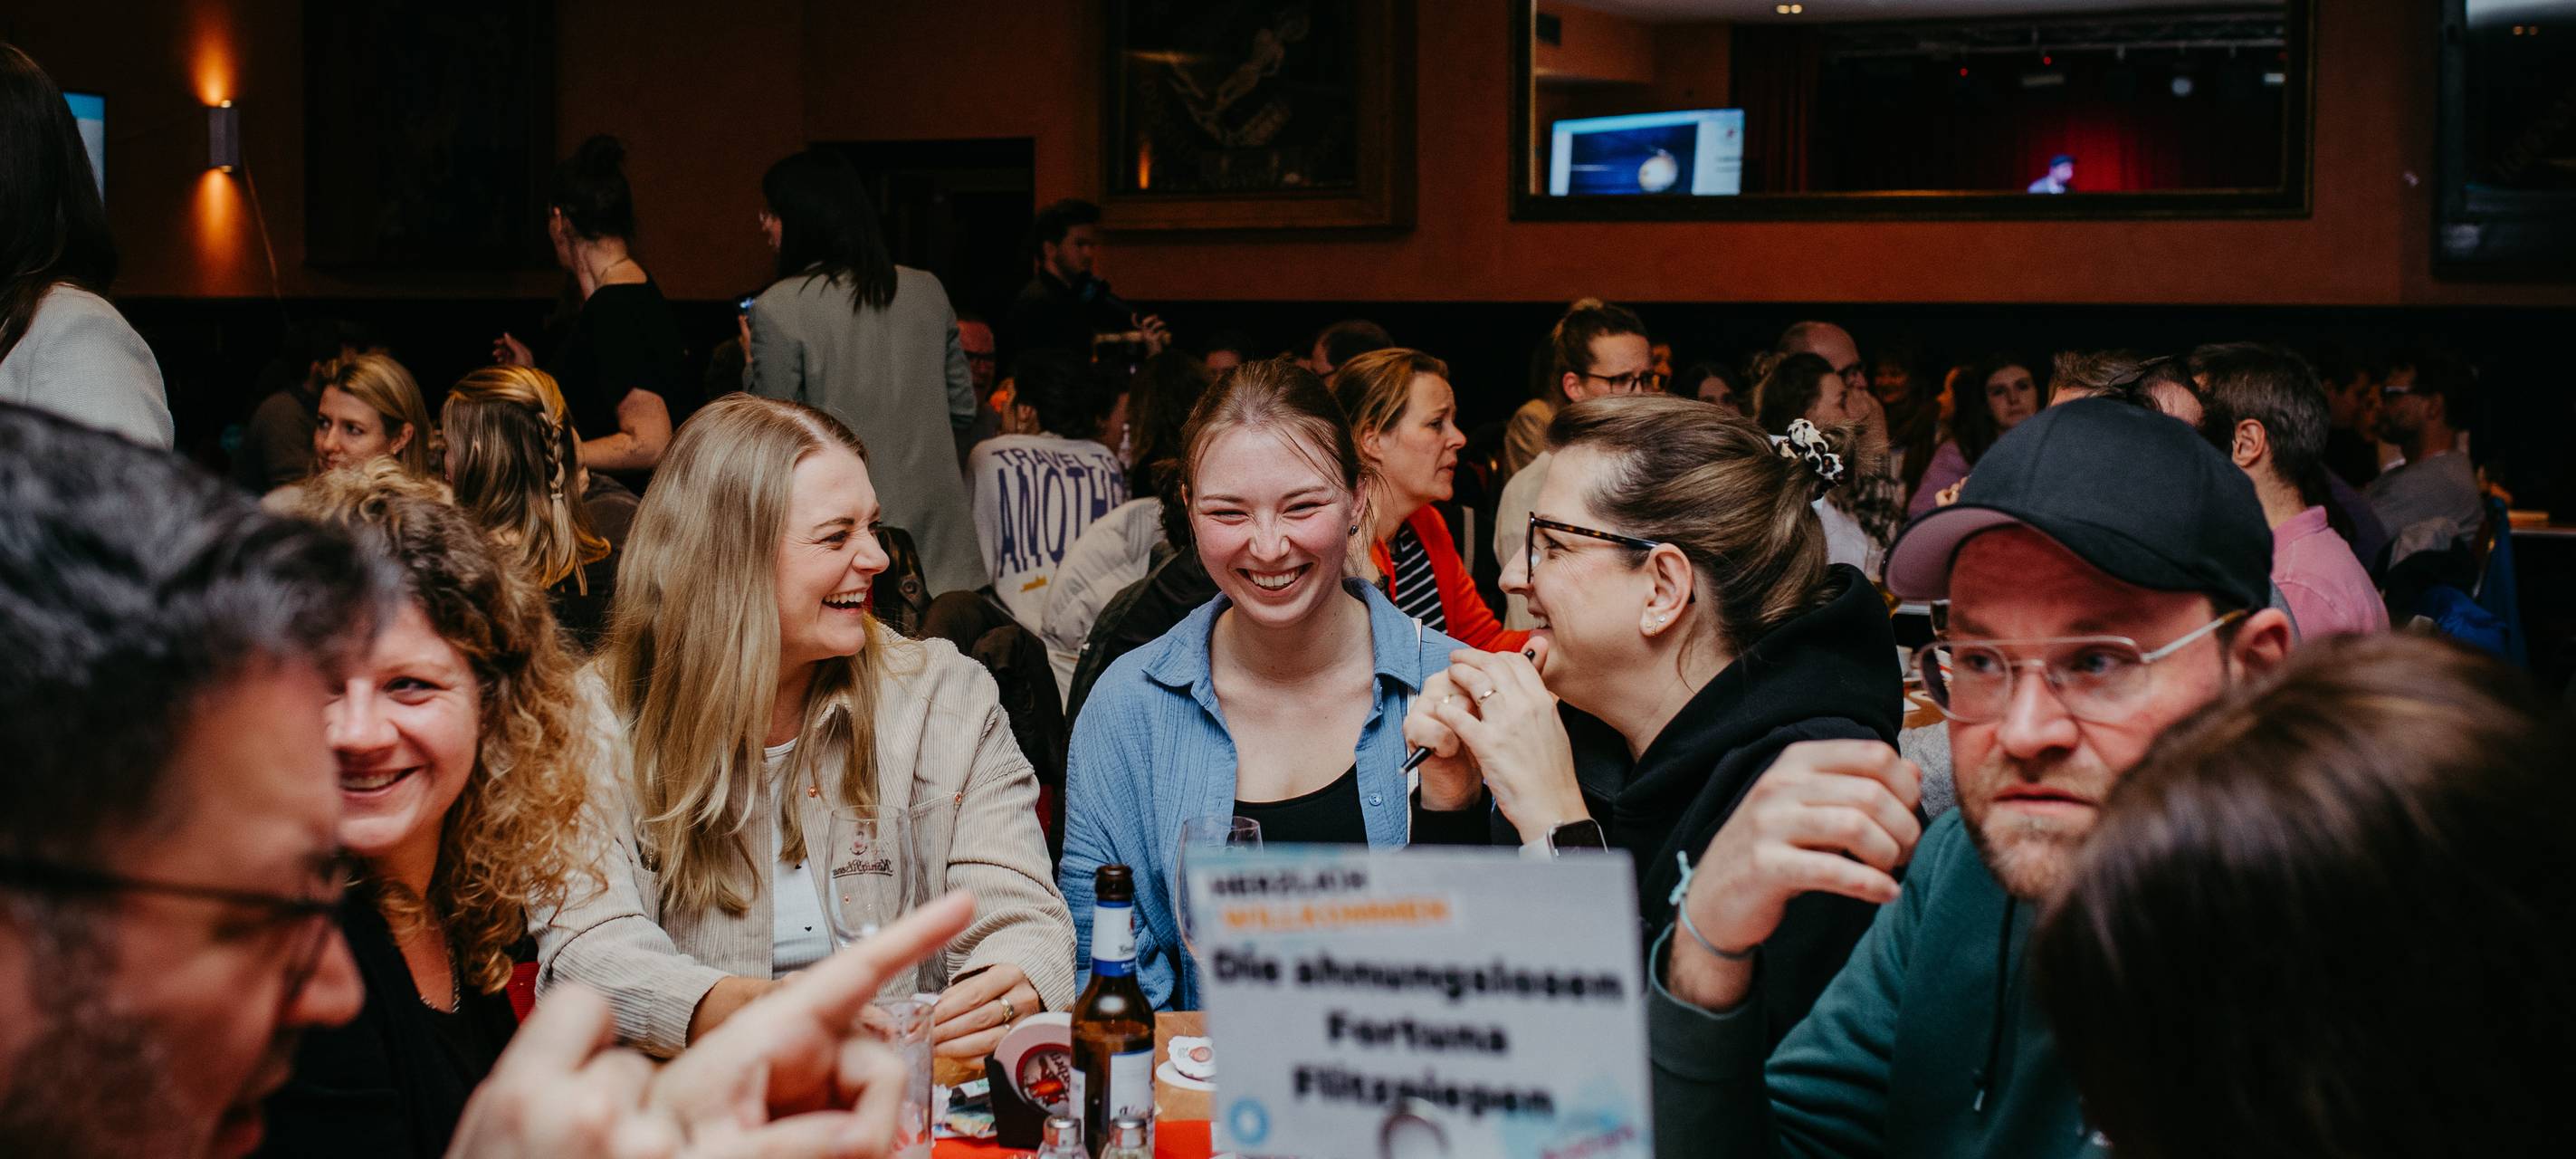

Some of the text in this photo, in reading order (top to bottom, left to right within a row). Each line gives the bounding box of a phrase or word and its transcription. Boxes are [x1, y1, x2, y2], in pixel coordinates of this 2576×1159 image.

[992, 449, 1094, 469] TRAVEL
[1210, 870, 1367, 896] HERZLICH
[1222, 897, 1450, 931] WILLKOMMEN
[1213, 948, 1623, 1001] Die ahnungslosen
[1327, 1011, 1508, 1053] Fortuna
